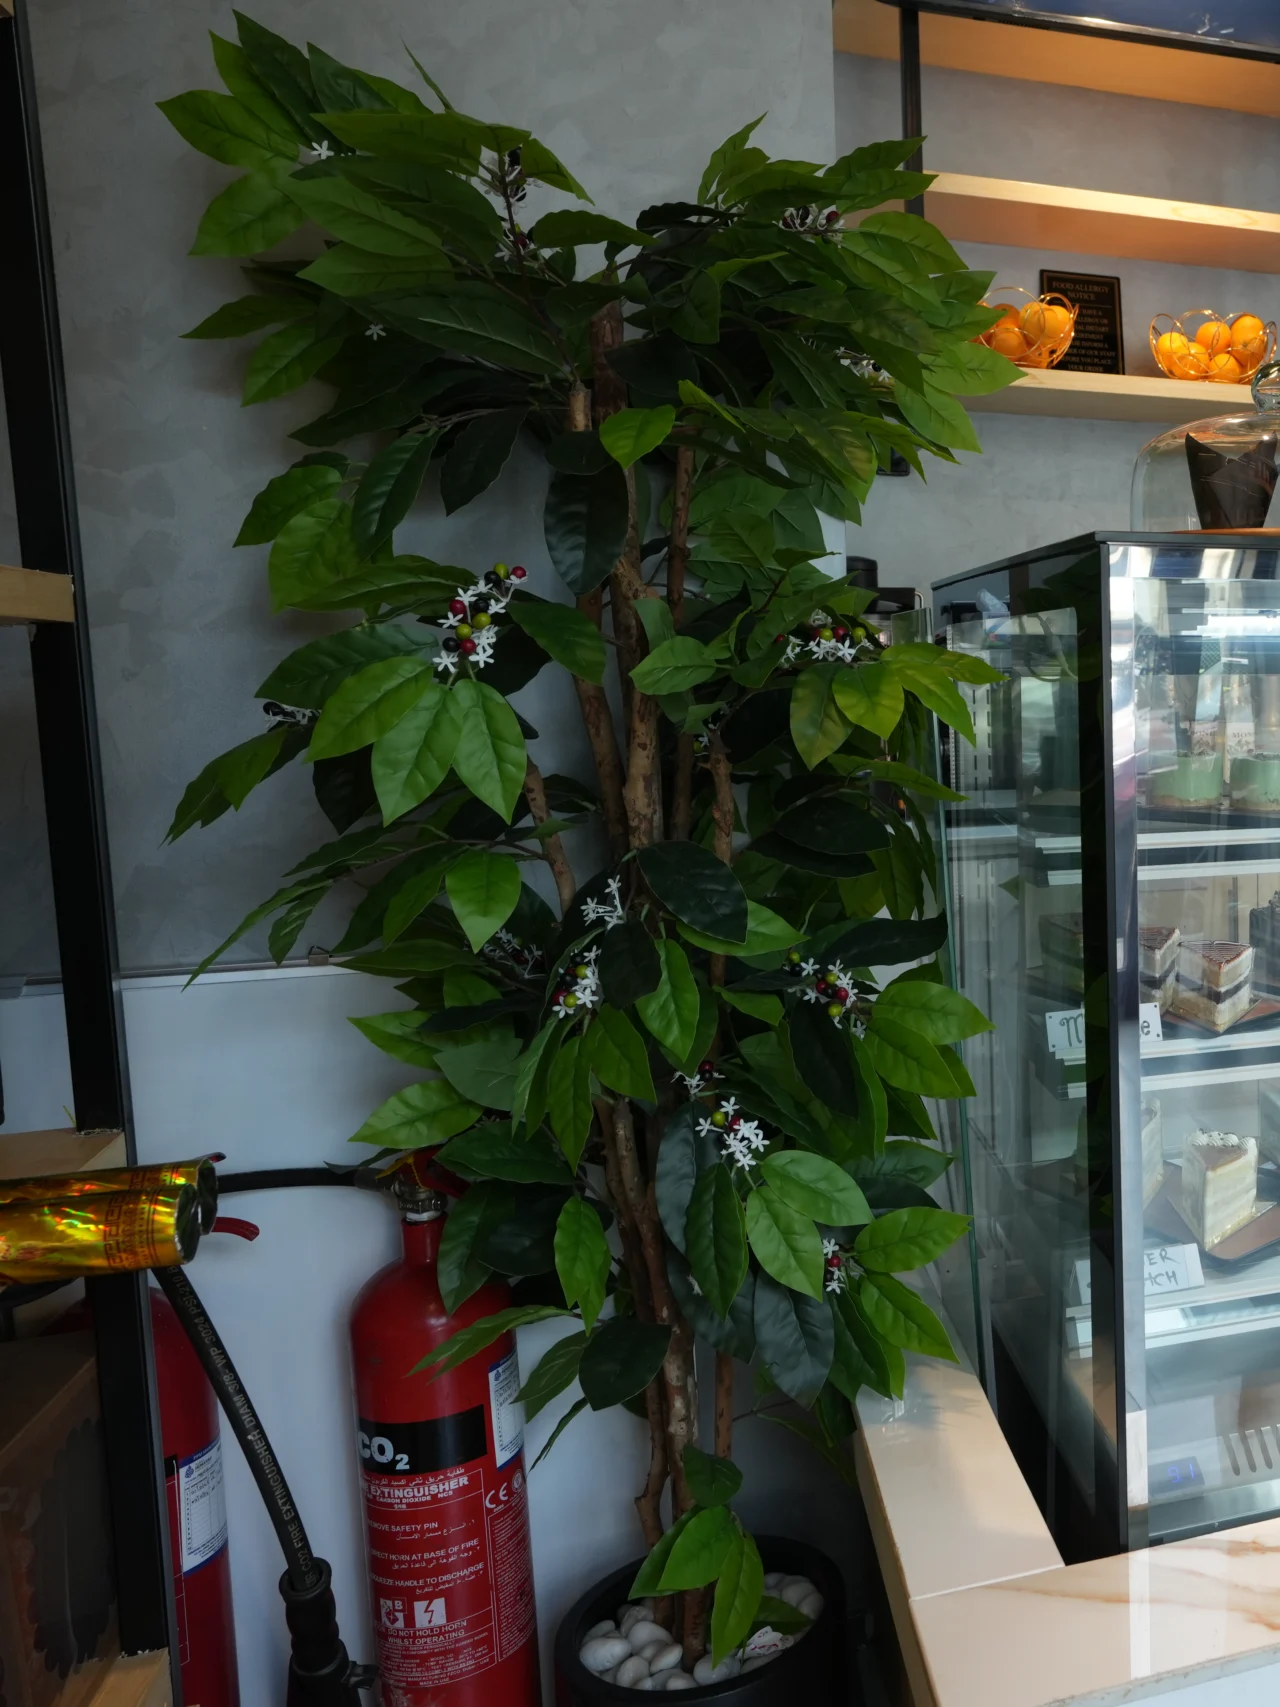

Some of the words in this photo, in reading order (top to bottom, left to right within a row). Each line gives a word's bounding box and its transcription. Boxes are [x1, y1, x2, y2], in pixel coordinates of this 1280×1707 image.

[1053, 281, 1073, 289] FOOD
[1068, 291, 1095, 301] NOTICE
[232, 1394, 257, 1429] DIAM
[249, 1429, 295, 1521] EXTINGUISHER
[370, 1475, 469, 1499] EXTINGUISHER
[402, 1495, 432, 1504] DIOXIDE
[288, 1520, 304, 1549] FIRE
[391, 1523, 422, 1532] SAFETY
[423, 1520, 439, 1530] PIN
[389, 1552, 410, 1561] HORN
[411, 1553, 422, 1561] AT
[423, 1549, 447, 1560] BASE
[448, 1544, 460, 1554] OF
[461, 1537, 480, 1550] FIRE
[395, 1579, 425, 1587] HANDLE
[426, 1576, 438, 1585] TO
[438, 1561, 485, 1583] DISCHARGE
[399, 1628, 415, 1637] NOT
[416, 1628, 441, 1637] HOLD
[441, 1620, 468, 1633] HORN
[415, 1629, 466, 1645] OPERATING
